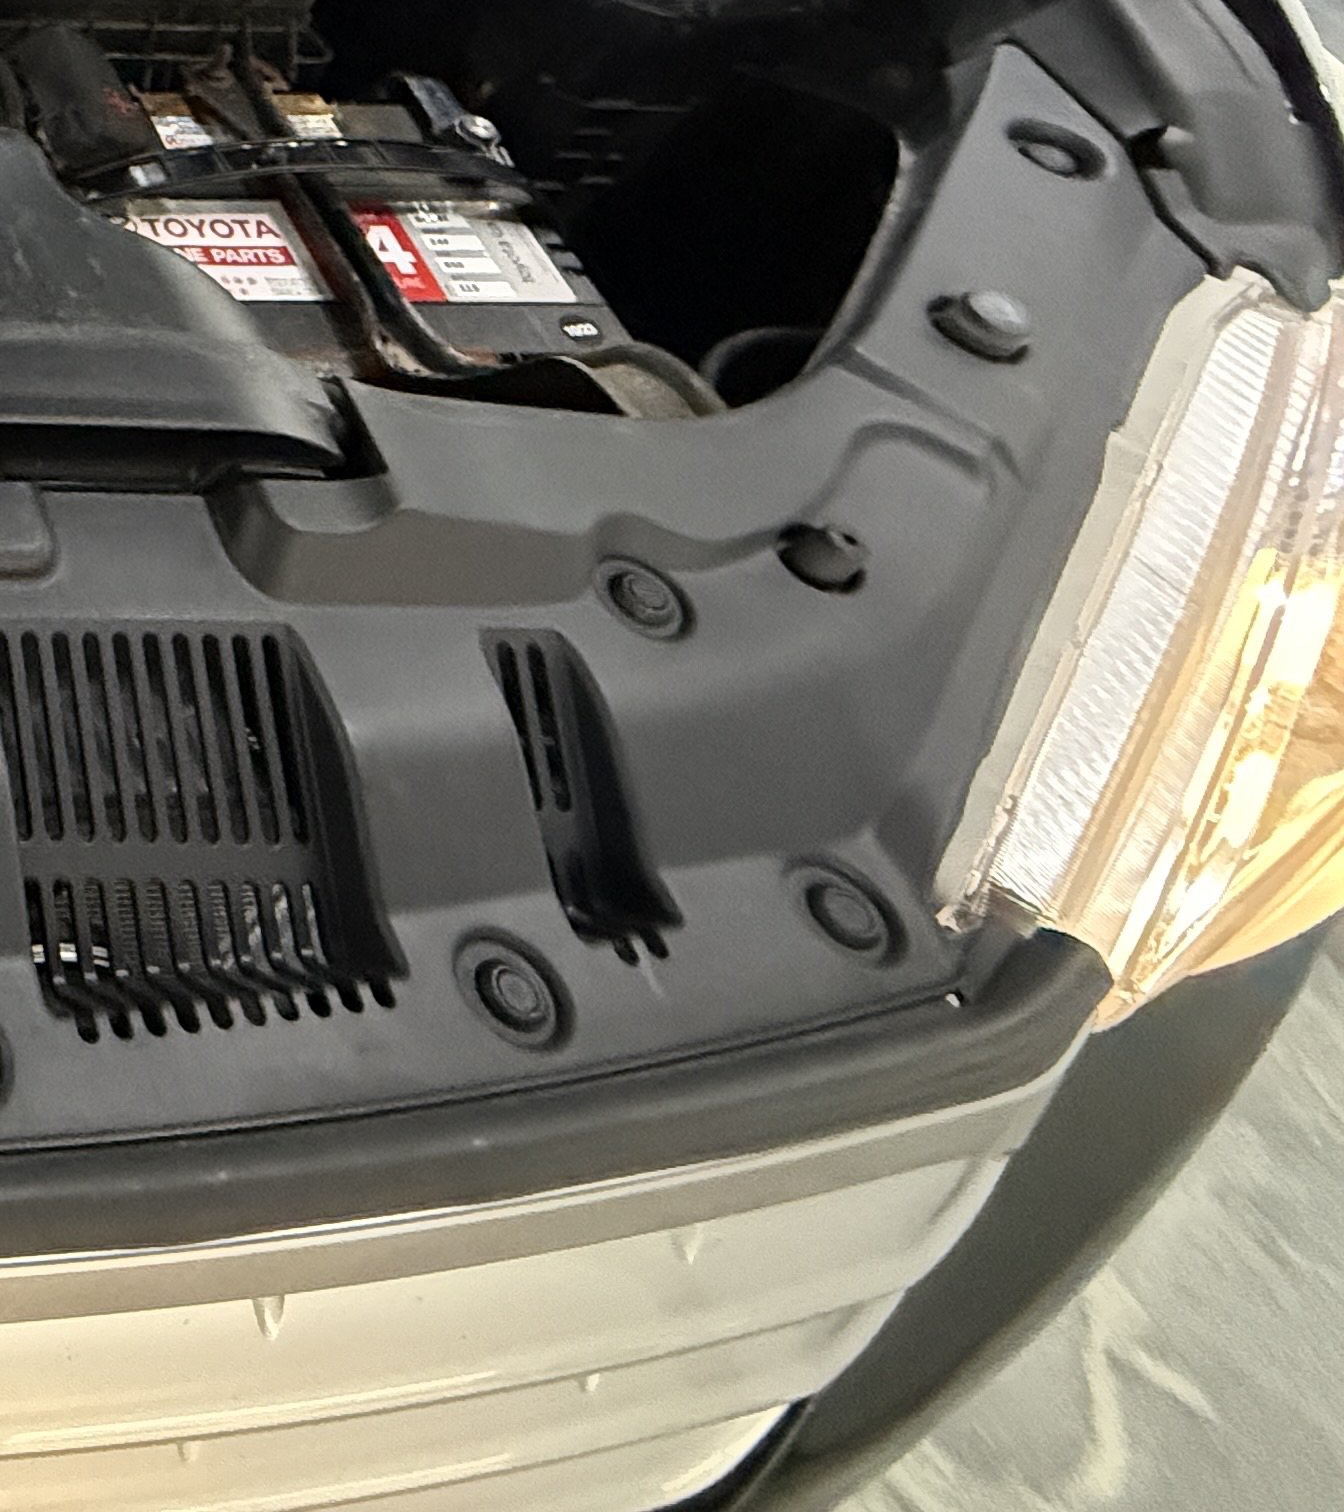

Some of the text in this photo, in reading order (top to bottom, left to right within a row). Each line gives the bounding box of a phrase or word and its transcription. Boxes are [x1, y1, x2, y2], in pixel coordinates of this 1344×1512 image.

[142, 217, 281, 239] TOYOTA
[209, 248, 286, 264] PARTS
[365, 225, 418, 275] 4
